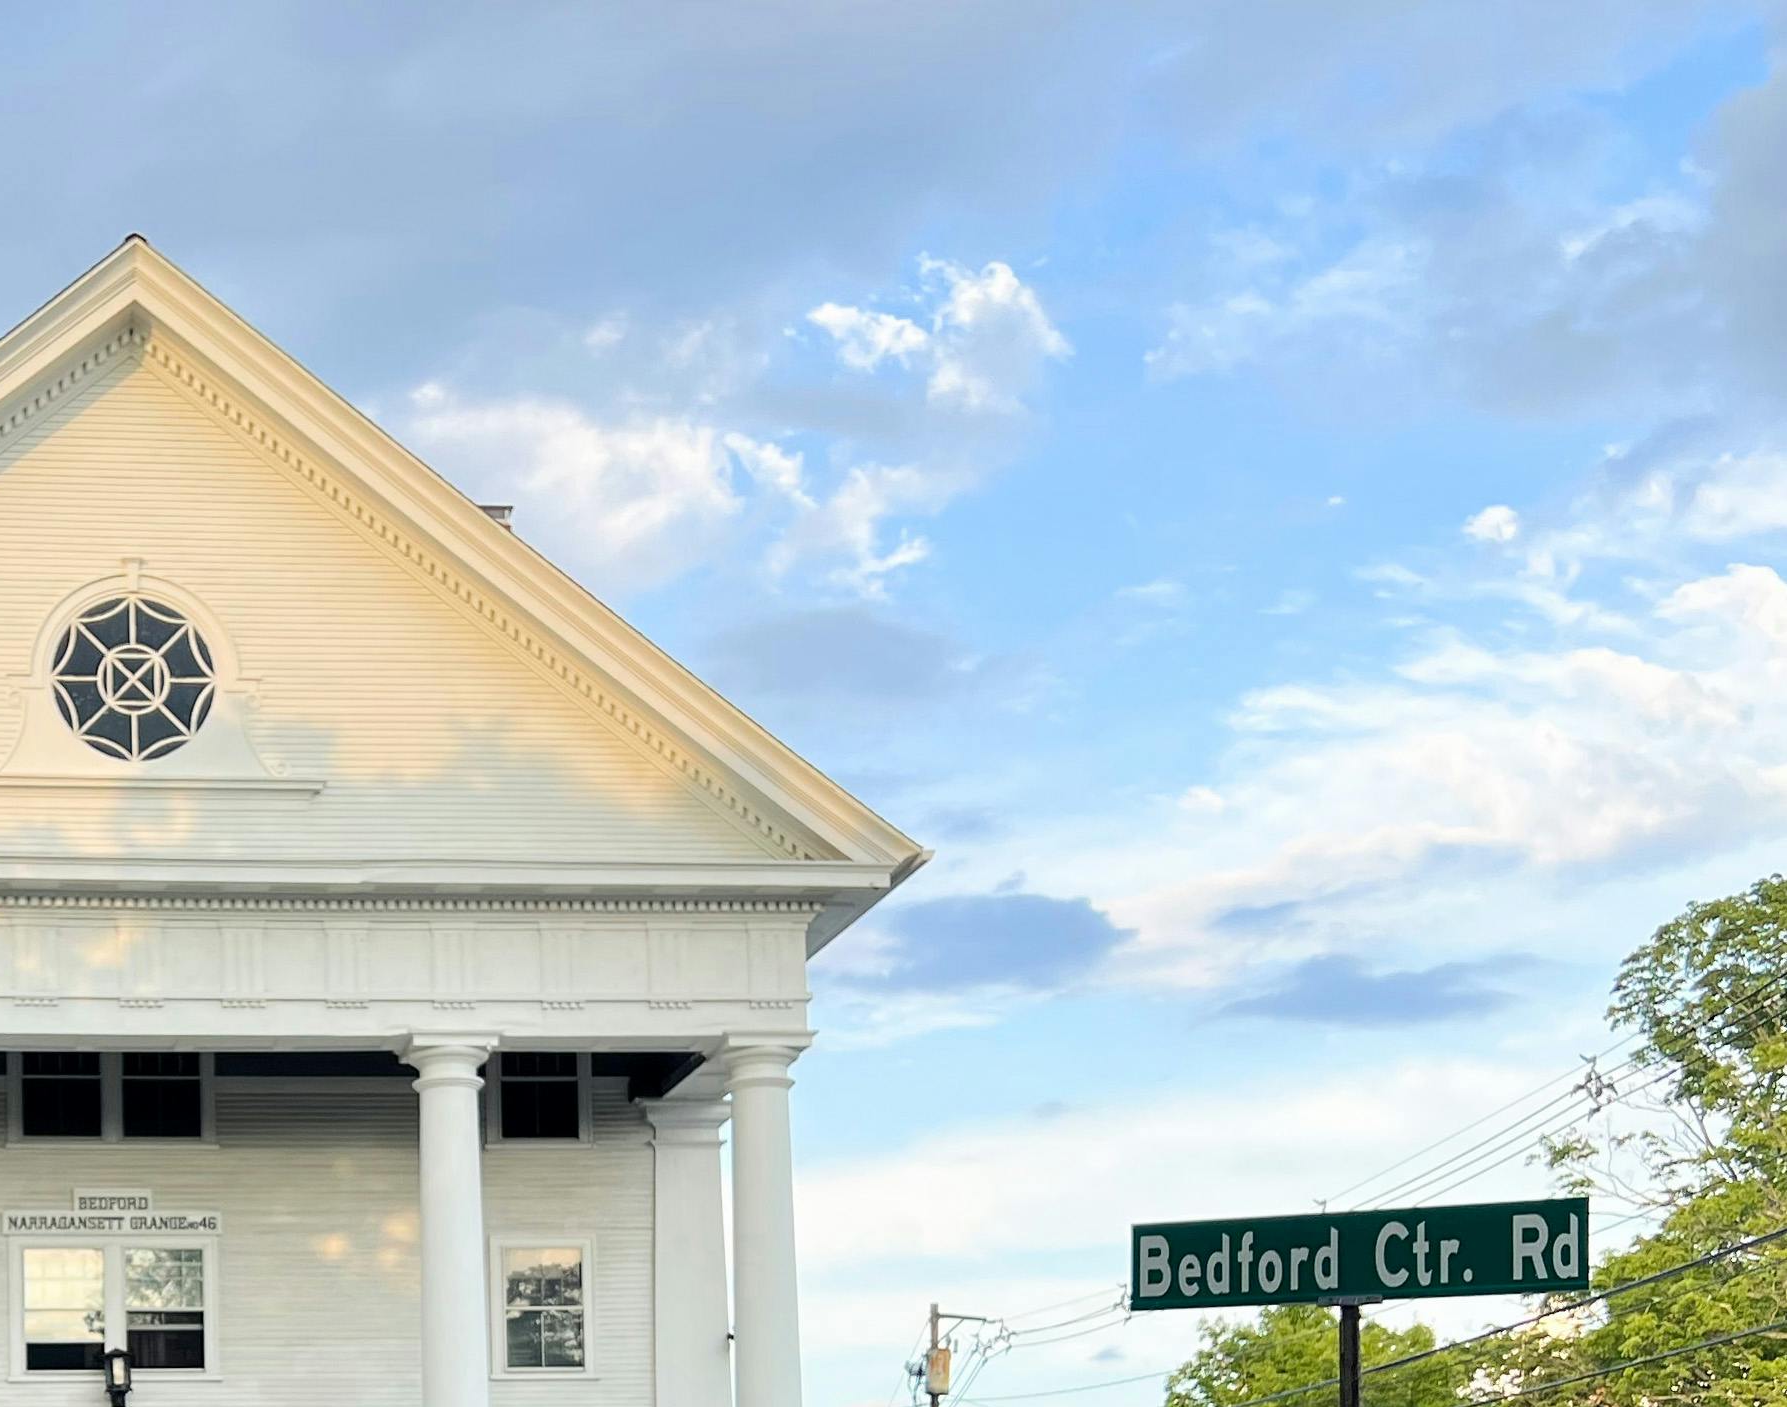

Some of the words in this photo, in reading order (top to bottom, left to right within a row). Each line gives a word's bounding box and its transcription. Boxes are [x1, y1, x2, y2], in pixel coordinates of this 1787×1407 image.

[78, 1196, 149, 1211] BEDFORD
[8, 1215, 125, 1231] NARRAGANSETT
[130, 1215, 186, 1231] GRANGE
[1139, 1226, 1340, 1298] Bedford
[1375, 1220, 1473, 1288] Ctr.
[1512, 1212, 1579, 1281] Rd
